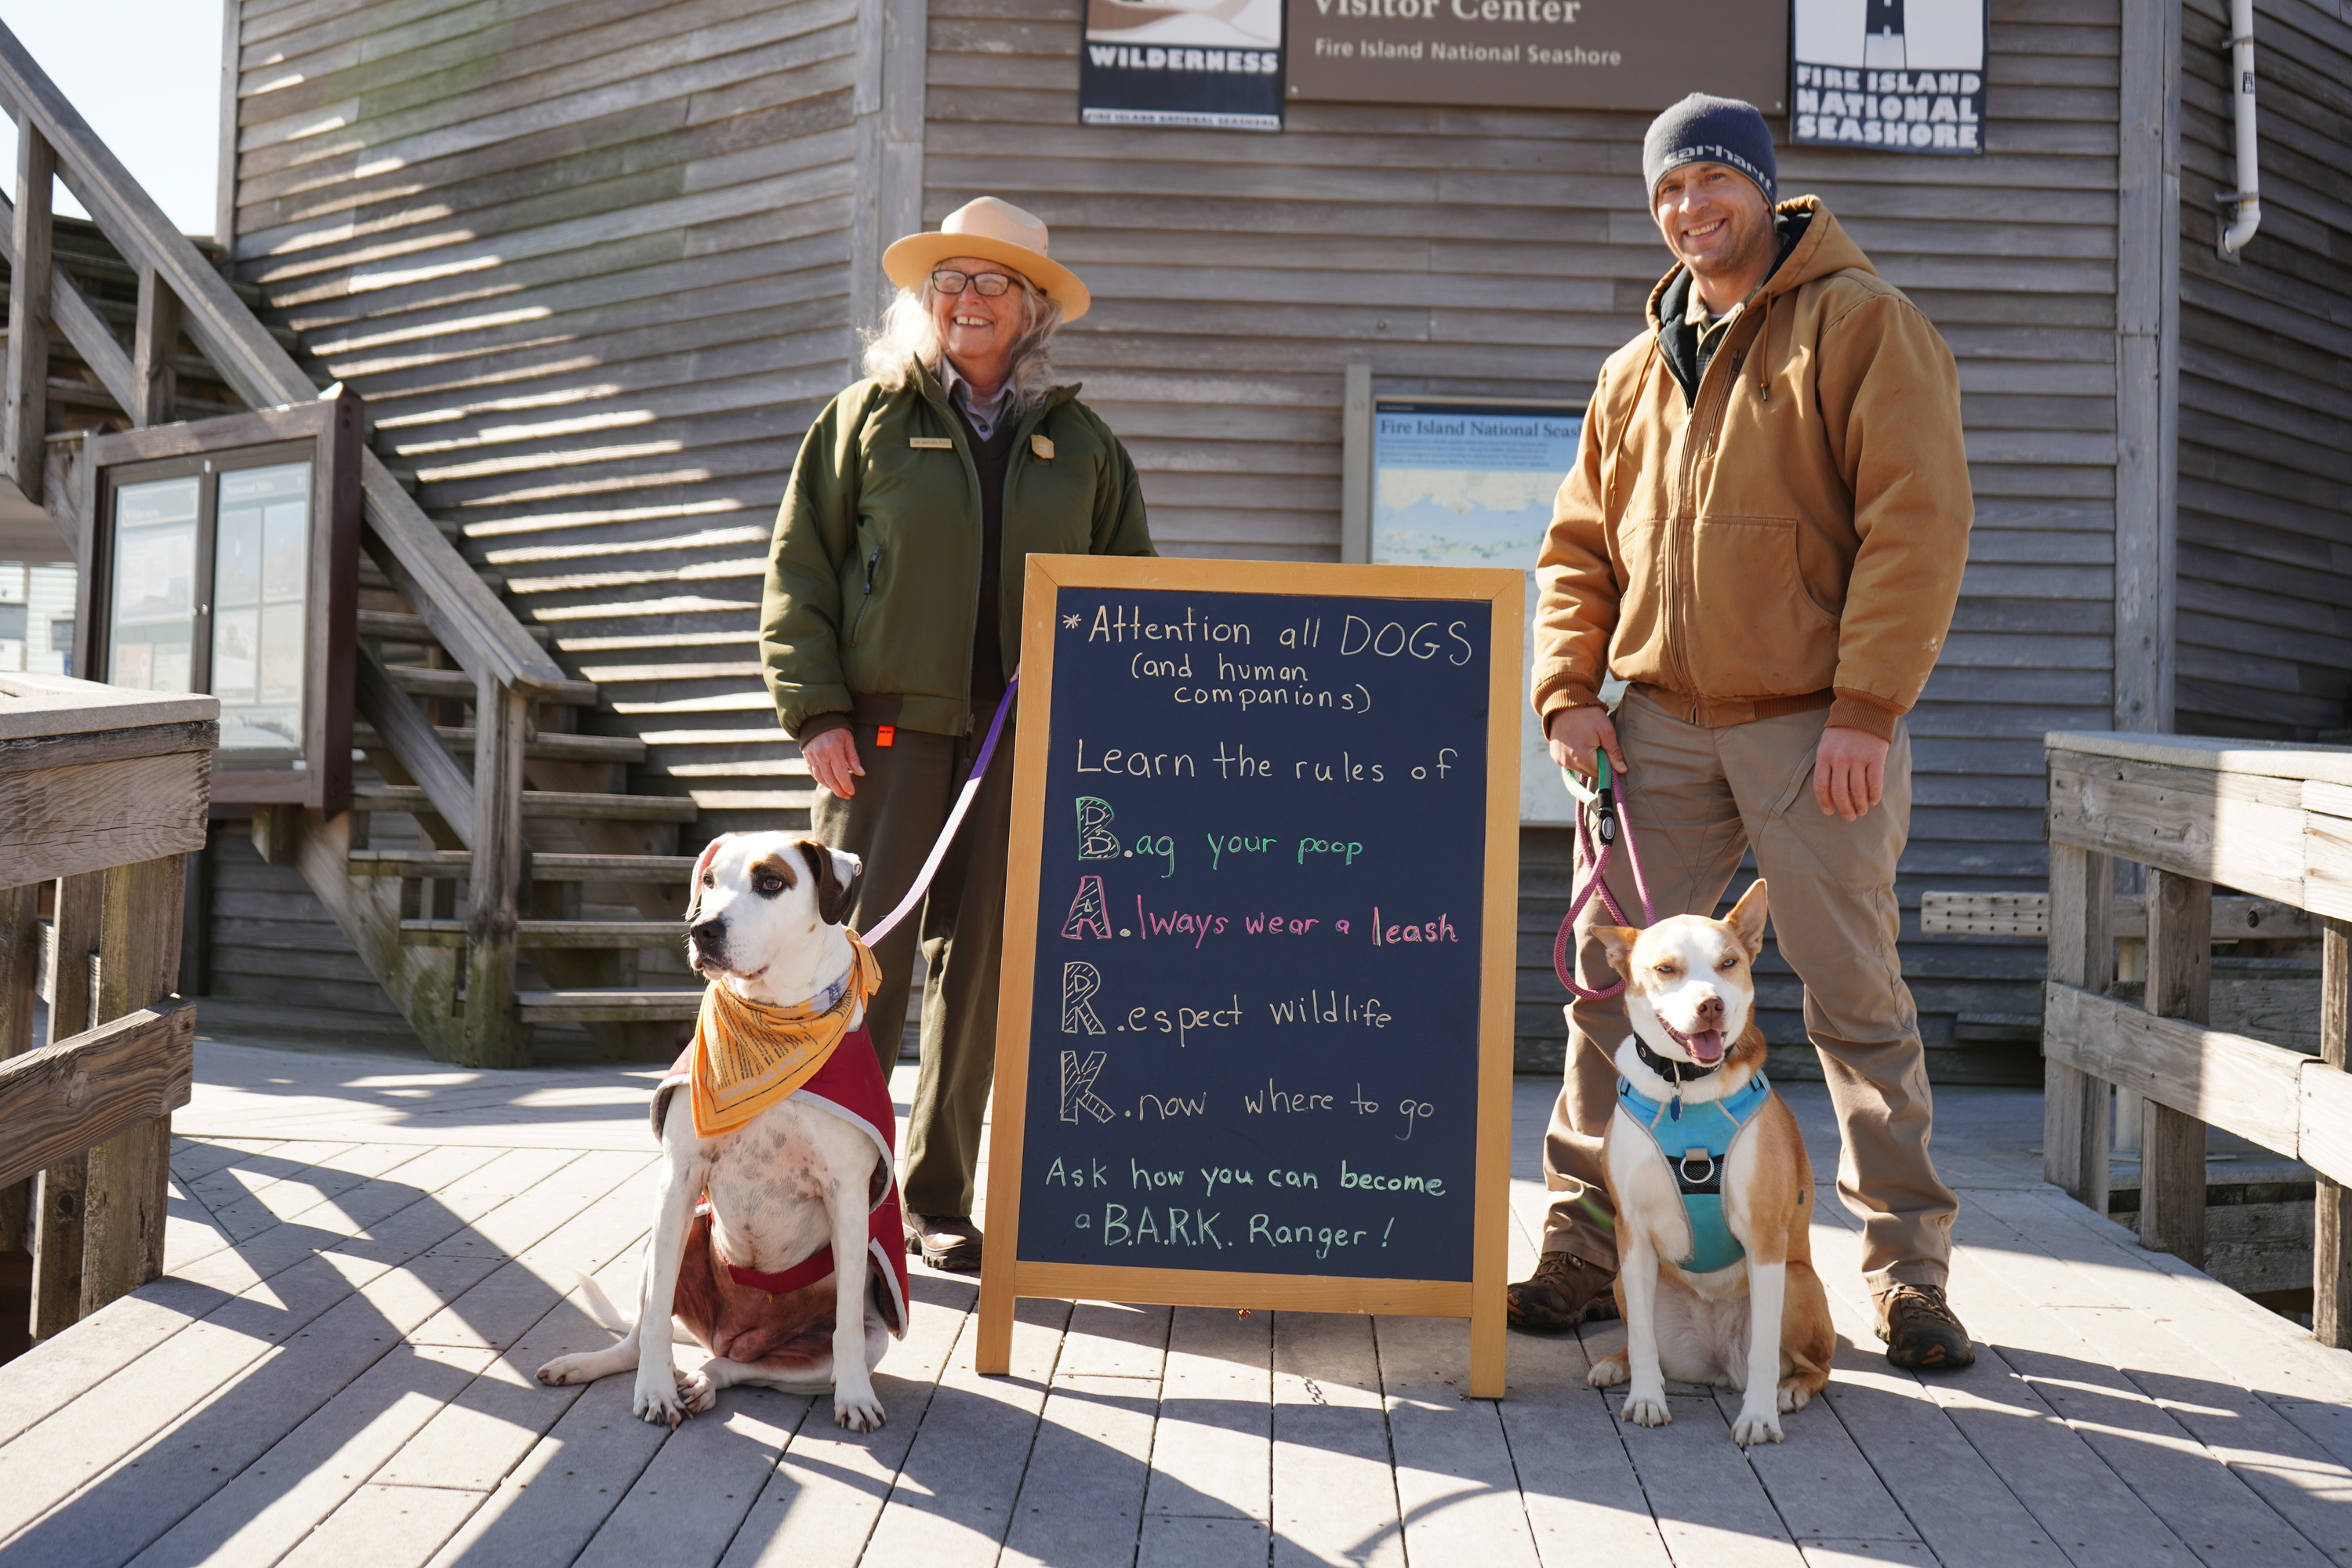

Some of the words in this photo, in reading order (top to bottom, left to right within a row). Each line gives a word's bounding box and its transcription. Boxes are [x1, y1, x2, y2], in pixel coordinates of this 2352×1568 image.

[1316, 0, 1439, 18] Visitor
[1452, 0, 1581, 23] Center
[1088, 45, 1278, 74] WILDERNESS
[1315, 38, 1354, 56] Fire
[1360, 40, 1423, 59] Island
[1431, 42, 1519, 62] National
[1527, 45, 1621, 66] Seashore
[1797, 65, 1860, 91] FIRE
[1867, 71, 1981, 94] ISLAND
[1797, 89, 1979, 122] NATIONAL
[1797, 115, 1979, 148] SEASHORE
[1664, 144, 1773, 191] carhartt
[1381, 419, 1412, 434] Fire
[1417, 419, 1465, 436] Island
[1471, 421, 1538, 438] National
[1279, 618, 1320, 649] all
[1340, 615, 1472, 666] DOGS
[1131, 652, 1192, 679] (and
[1218, 652, 1308, 681] human
[1174, 683, 1370, 714] companions)
[1077, 739, 1195, 779] Learn
[1212, 741, 1272, 779] the
[1295, 751, 1385, 782] rules
[1410, 747, 1458, 780] of
[1207, 833, 1277, 870] your
[1298, 837, 1363, 866] poop
[1245, 912, 1319, 935] wear
[1335, 919, 1350, 935] a
[1372, 906, 1458, 946] leash
[1269, 989, 1392, 1029] wildlife
[777, 1048, 806, 1073] STAY
[1244, 1078, 1334, 1114] where
[1350, 1083, 1379, 1115] to
[1395, 1099, 1434, 1140] go
[1046, 1156, 1107, 1188] Ask
[1131, 1158, 1185, 1191] how
[1200, 1166, 1254, 1197] you
[1268, 1169, 1319, 1189] can
[1340, 1160, 1446, 1196] become
[1075, 1214, 1091, 1229] a
[1104, 1203, 1233, 1250] B.A.R.K.
